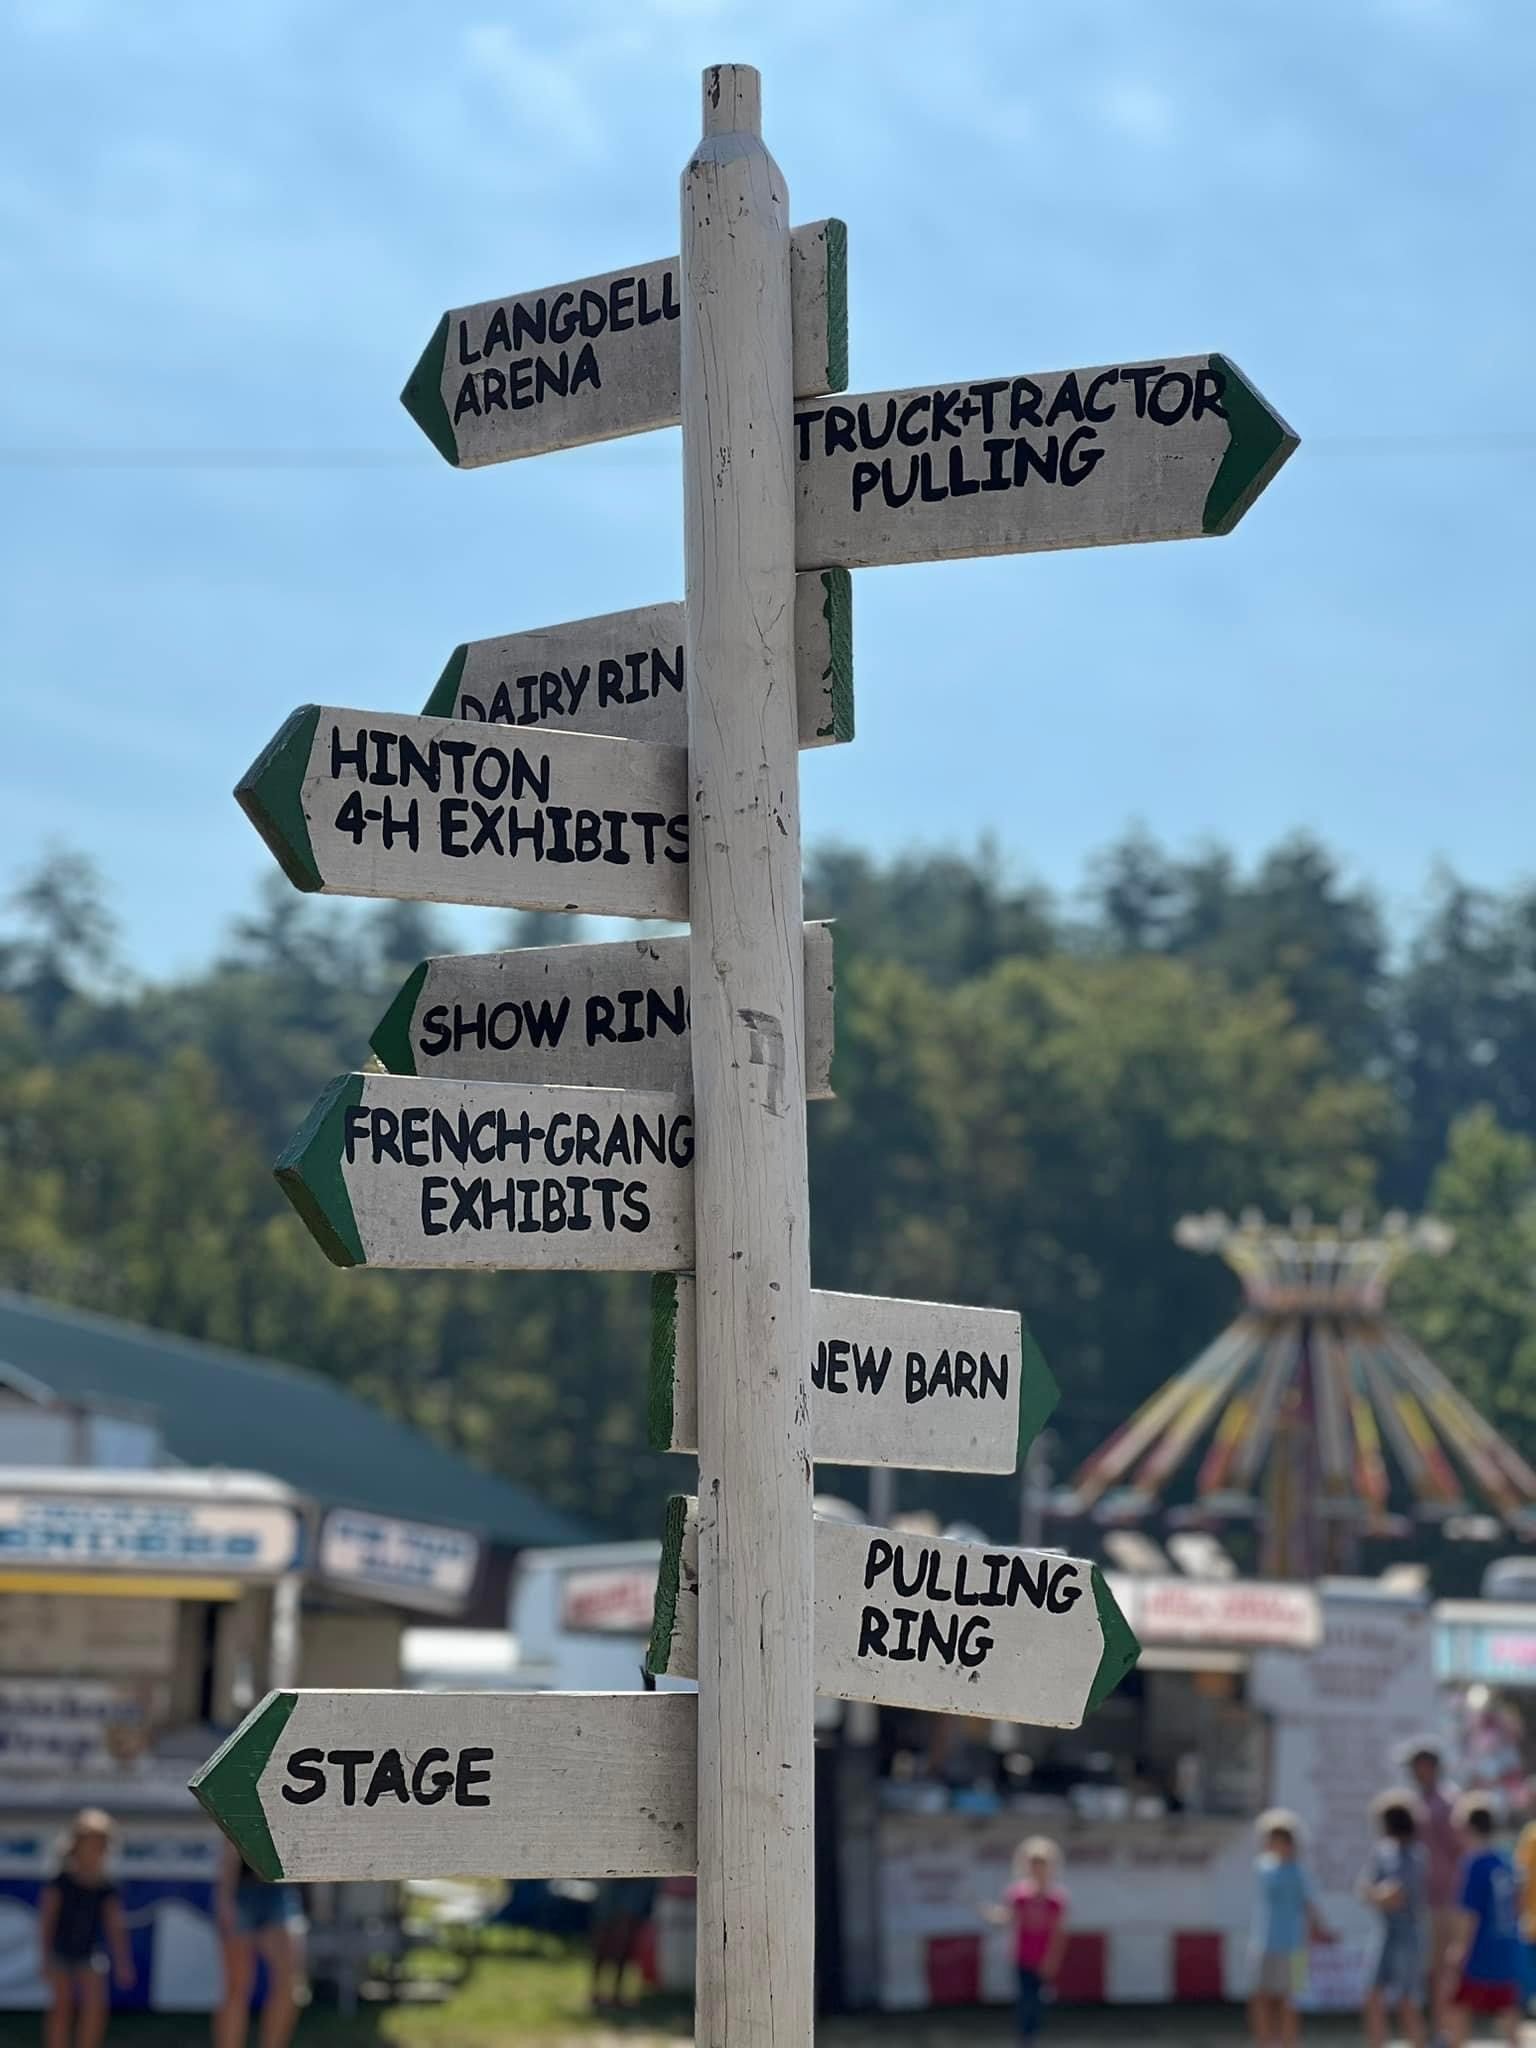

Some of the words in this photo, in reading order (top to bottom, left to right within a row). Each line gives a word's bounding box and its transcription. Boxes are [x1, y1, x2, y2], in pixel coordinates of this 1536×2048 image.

[459, 272, 680, 366] LANGDELL
[454, 342, 601, 426] ARENA
[794, 365, 1230, 461] TRUCK+TRACTOR
[852, 426, 1105, 512] PULLING
[331, 726, 549, 803] HINTON
[335, 790, 418, 852] 4-H
[440, 798, 689, 865] EXHIBITS
[419, 996, 570, 1056] SHOW
[585, 986, 691, 1047] RIN
[422, 1176, 650, 1236] EXHIBITS
[906, 1350, 1008, 1404] BARN
[864, 1538, 1083, 1614] PULLING
[858, 1606, 994, 1667] RING
[281, 1747, 494, 1807] STAGE
